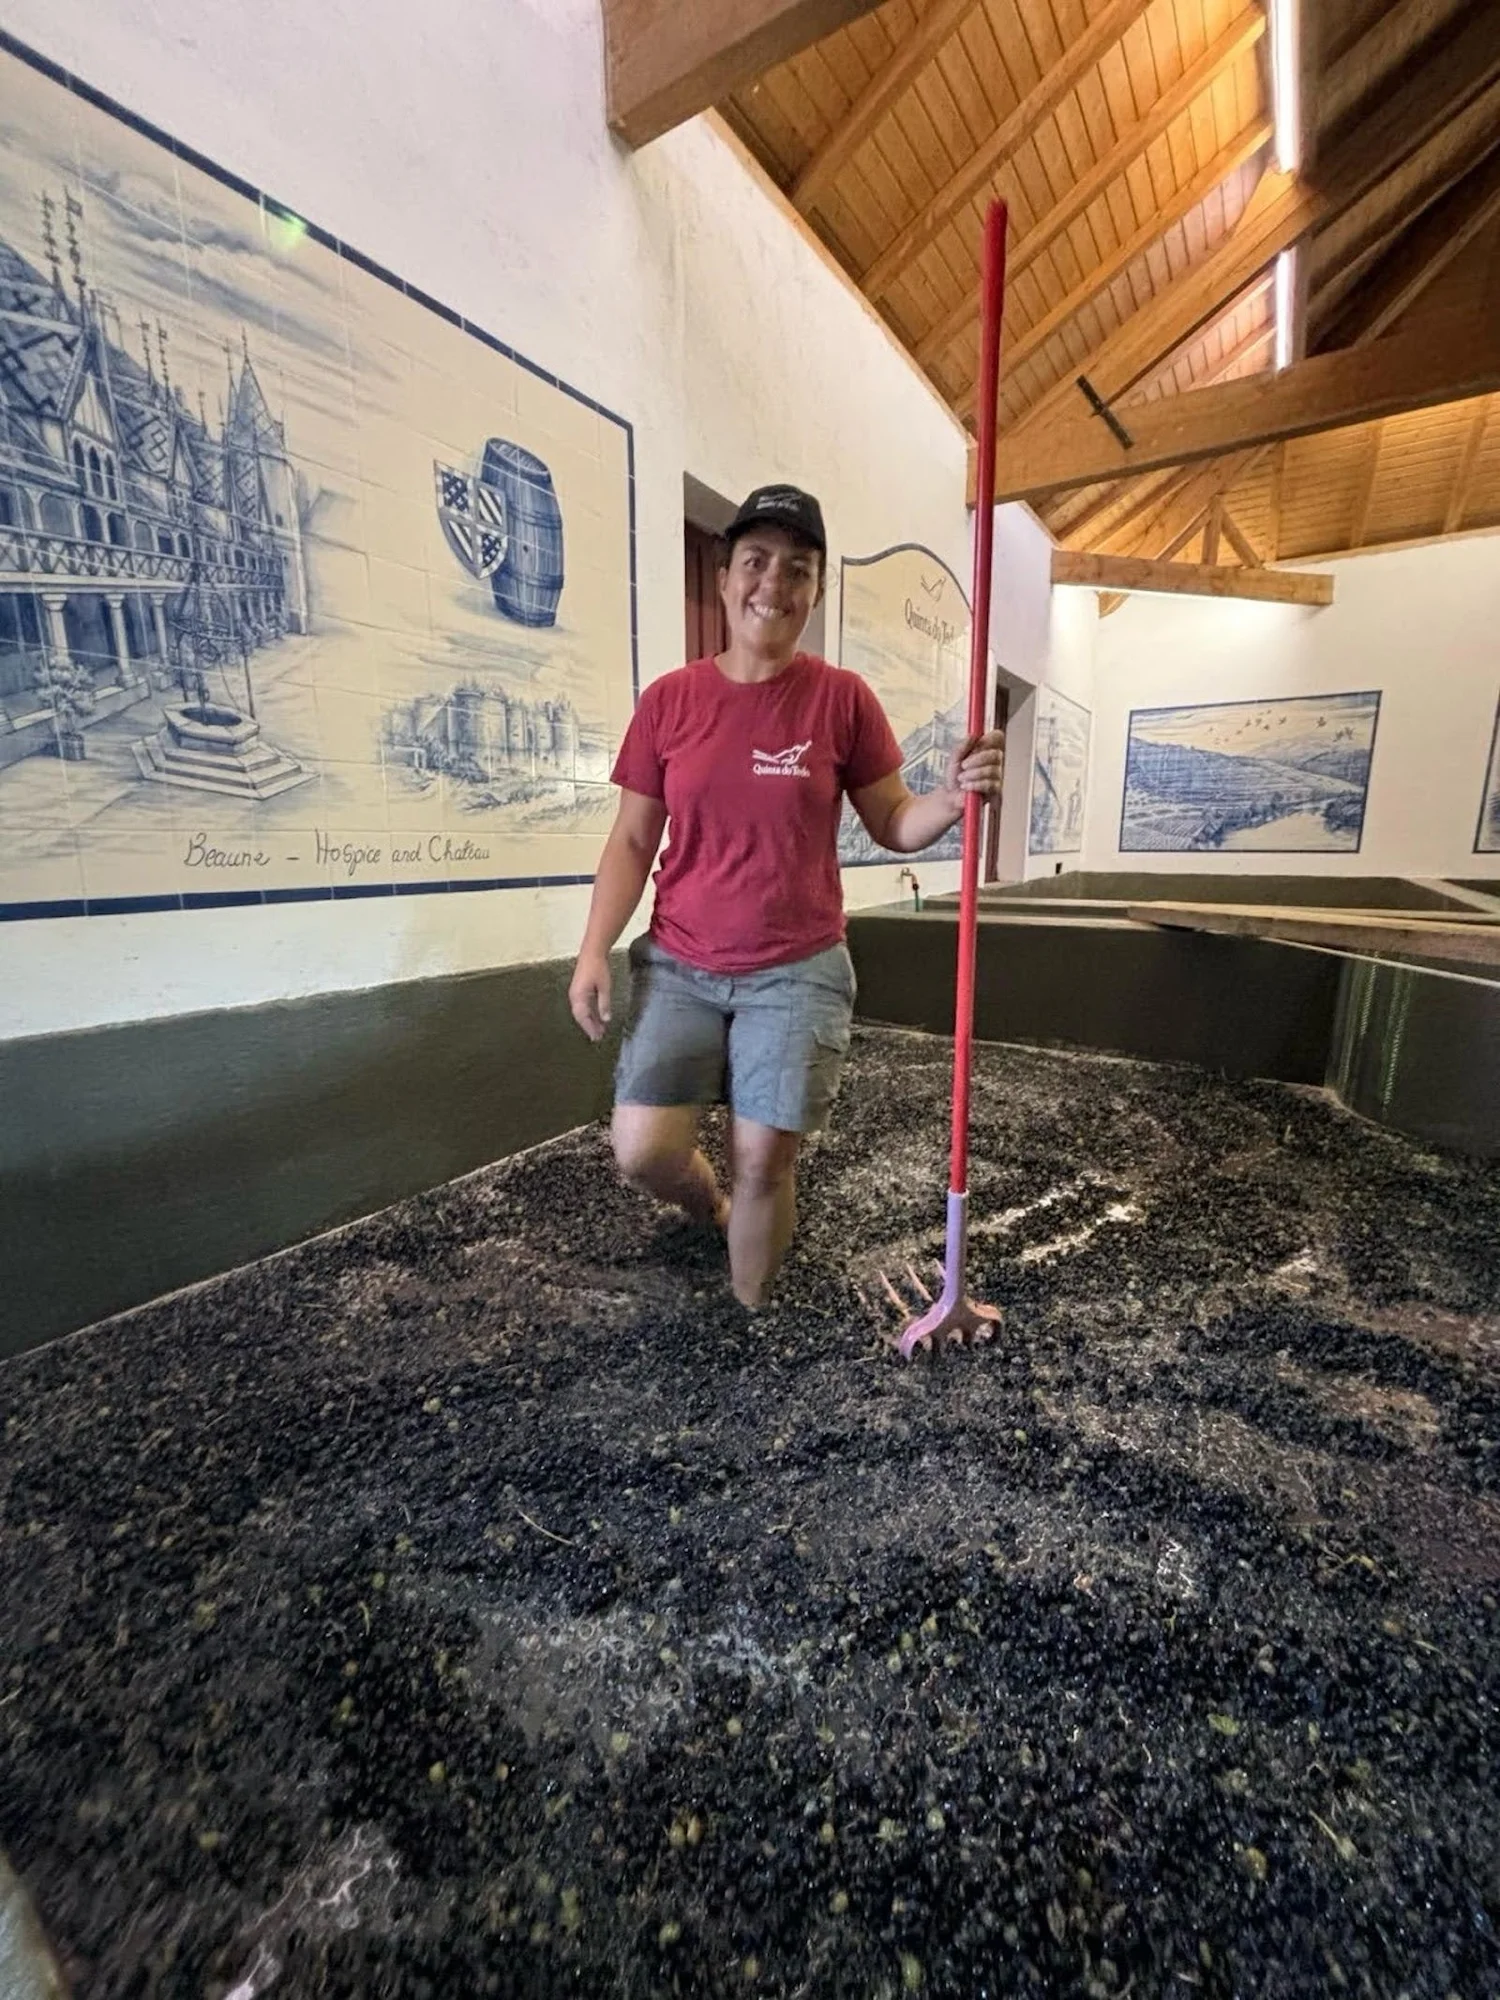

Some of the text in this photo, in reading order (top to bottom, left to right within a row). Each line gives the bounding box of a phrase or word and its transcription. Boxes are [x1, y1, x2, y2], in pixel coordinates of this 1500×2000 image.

[183, 832, 271, 868] Beaune
[315, 829, 381, 876] Hospice
[391, 841, 422, 862] and
